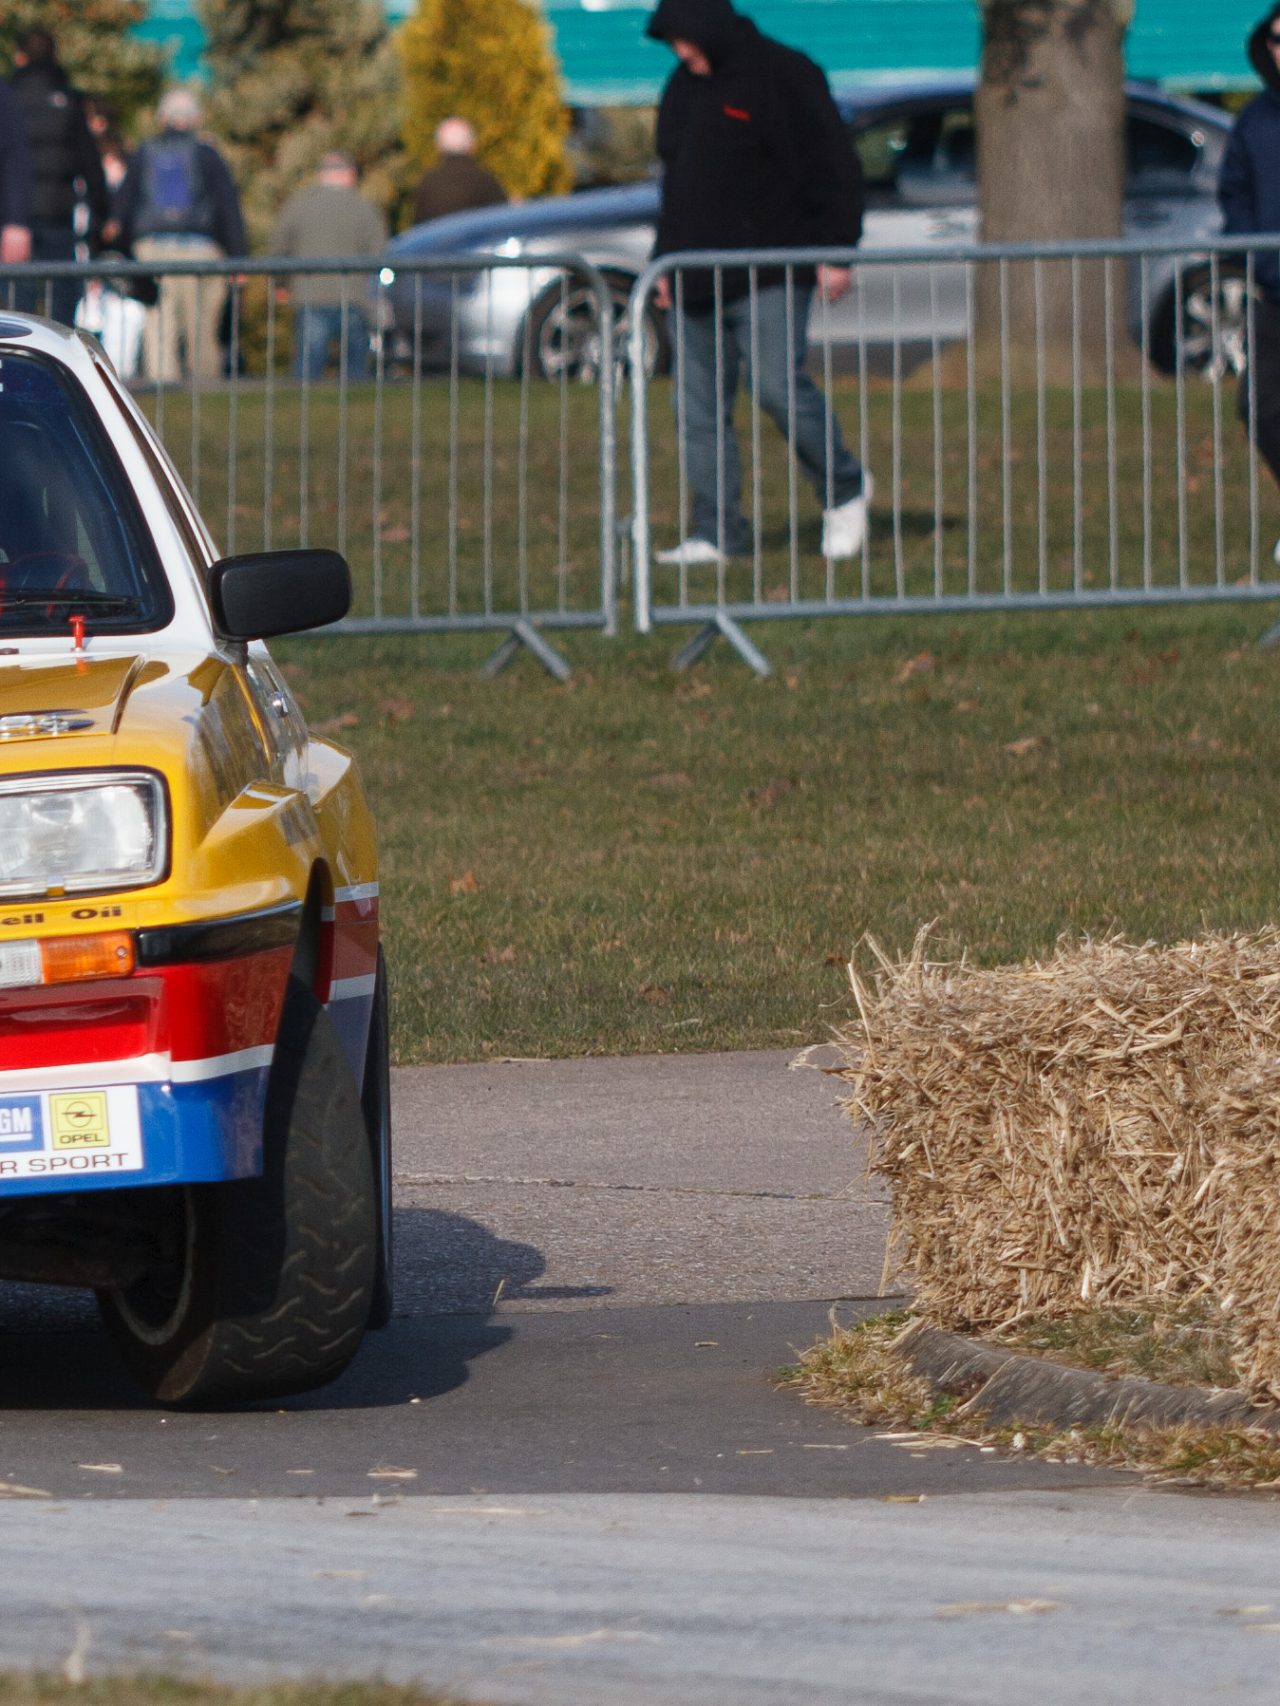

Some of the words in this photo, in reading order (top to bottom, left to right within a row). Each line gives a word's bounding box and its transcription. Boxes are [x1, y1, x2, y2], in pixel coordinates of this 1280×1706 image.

[71, 906, 122, 920] Oil
[59, 1133, 104, 1145] OPEL
[28, 1153, 128, 1173] SPORT
